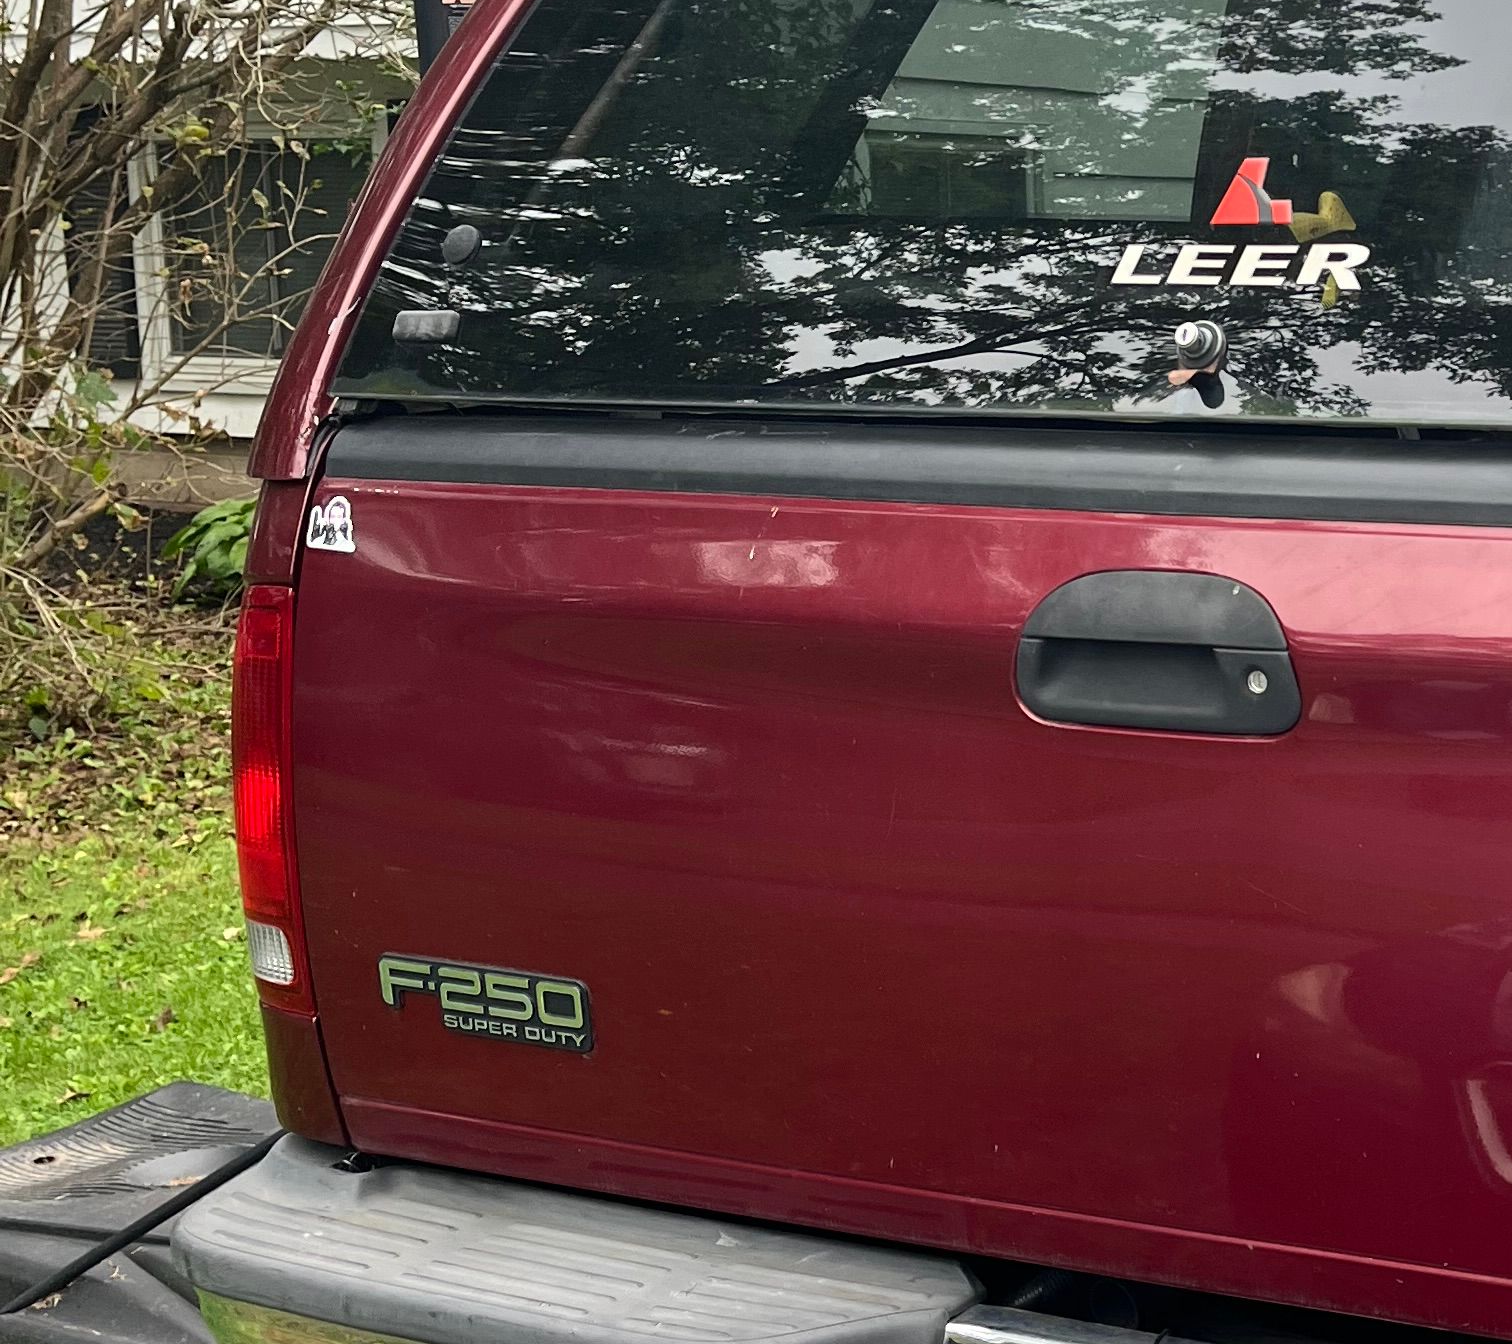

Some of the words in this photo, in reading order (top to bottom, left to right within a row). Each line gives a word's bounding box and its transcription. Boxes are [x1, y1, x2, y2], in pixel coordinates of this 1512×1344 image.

[1110, 243, 1371, 290] LEER
[443, 1014, 518, 1038] SUPER
[524, 1025, 586, 1047] DUTY
